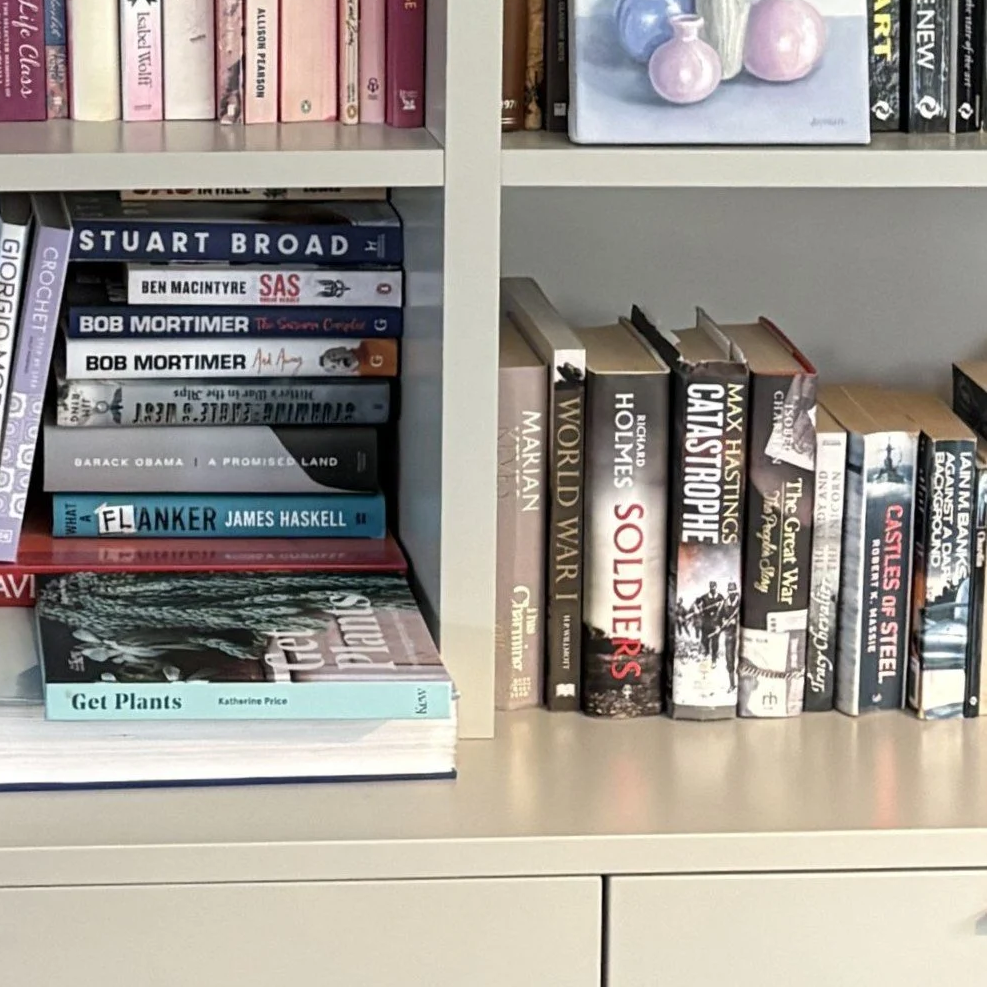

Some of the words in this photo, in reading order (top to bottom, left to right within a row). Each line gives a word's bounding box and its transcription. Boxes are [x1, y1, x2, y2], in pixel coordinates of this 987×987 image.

[136, 12, 150, 50] Isabel
[256, 7, 266, 49] ALLISON
[916, 11, 936, 69] NEW
[18, 44, 39, 99] Class
[138, 51, 152, 87] Wolff
[256, 53, 266, 99] PEARSON
[79, 230, 209, 254] STUART
[231, 232, 350, 256] BROAD
[30, 247, 60, 334] CROCHET
[141, 281, 168, 294] BEN
[171, 281, 247, 295] MACINTYRE
[259, 274, 301, 297] SAS
[79, 316, 123, 332] BOB
[129, 316, 249, 333] MORTIMER
[85, 355, 127, 371] BOB
[133, 354, 247, 370] MORTIMER
[722, 383, 744, 431] MAX
[75, 458, 129, 467] BARACK
[135, 458, 184, 467] OBAMA
[209, 458, 218, 466] A
[223, 458, 297, 467] PROMISED
[301, 457, 338, 467] LAND
[521, 410, 542, 513] MARIAN
[555, 398, 581, 508] WORLD
[613, 393, 635, 489] HOLMES
[636, 414, 646, 467] RICHARD
[681, 383, 724, 543] CATASTROPHE
[721, 439, 742, 545] HASTINGS
[785, 478, 803, 514] The
[65, 503, 76, 536] WHAT
[102, 505, 217, 532] FLANKER
[225, 508, 275, 528] JAMES
[280, 509, 347, 528] HASKELL
[555, 516, 579, 589] WAR
[783, 517, 802, 568] Great
[870, 539, 881, 589] ROBERT
[882, 504, 904, 591] CASTLES
[555, 593, 578, 601] I
[610, 503, 645, 680] SOLDIERS
[779, 570, 800, 605] War
[869, 592, 879, 604] K.
[881, 596, 898, 618] OF
[867, 608, 878, 653] MASSIE
[878, 622, 899, 684] STEEL
[71, 692, 107, 711] Get
[115, 692, 182, 711] Plants
[218, 697, 262, 706] Katherine
[265, 697, 288, 706] Price
